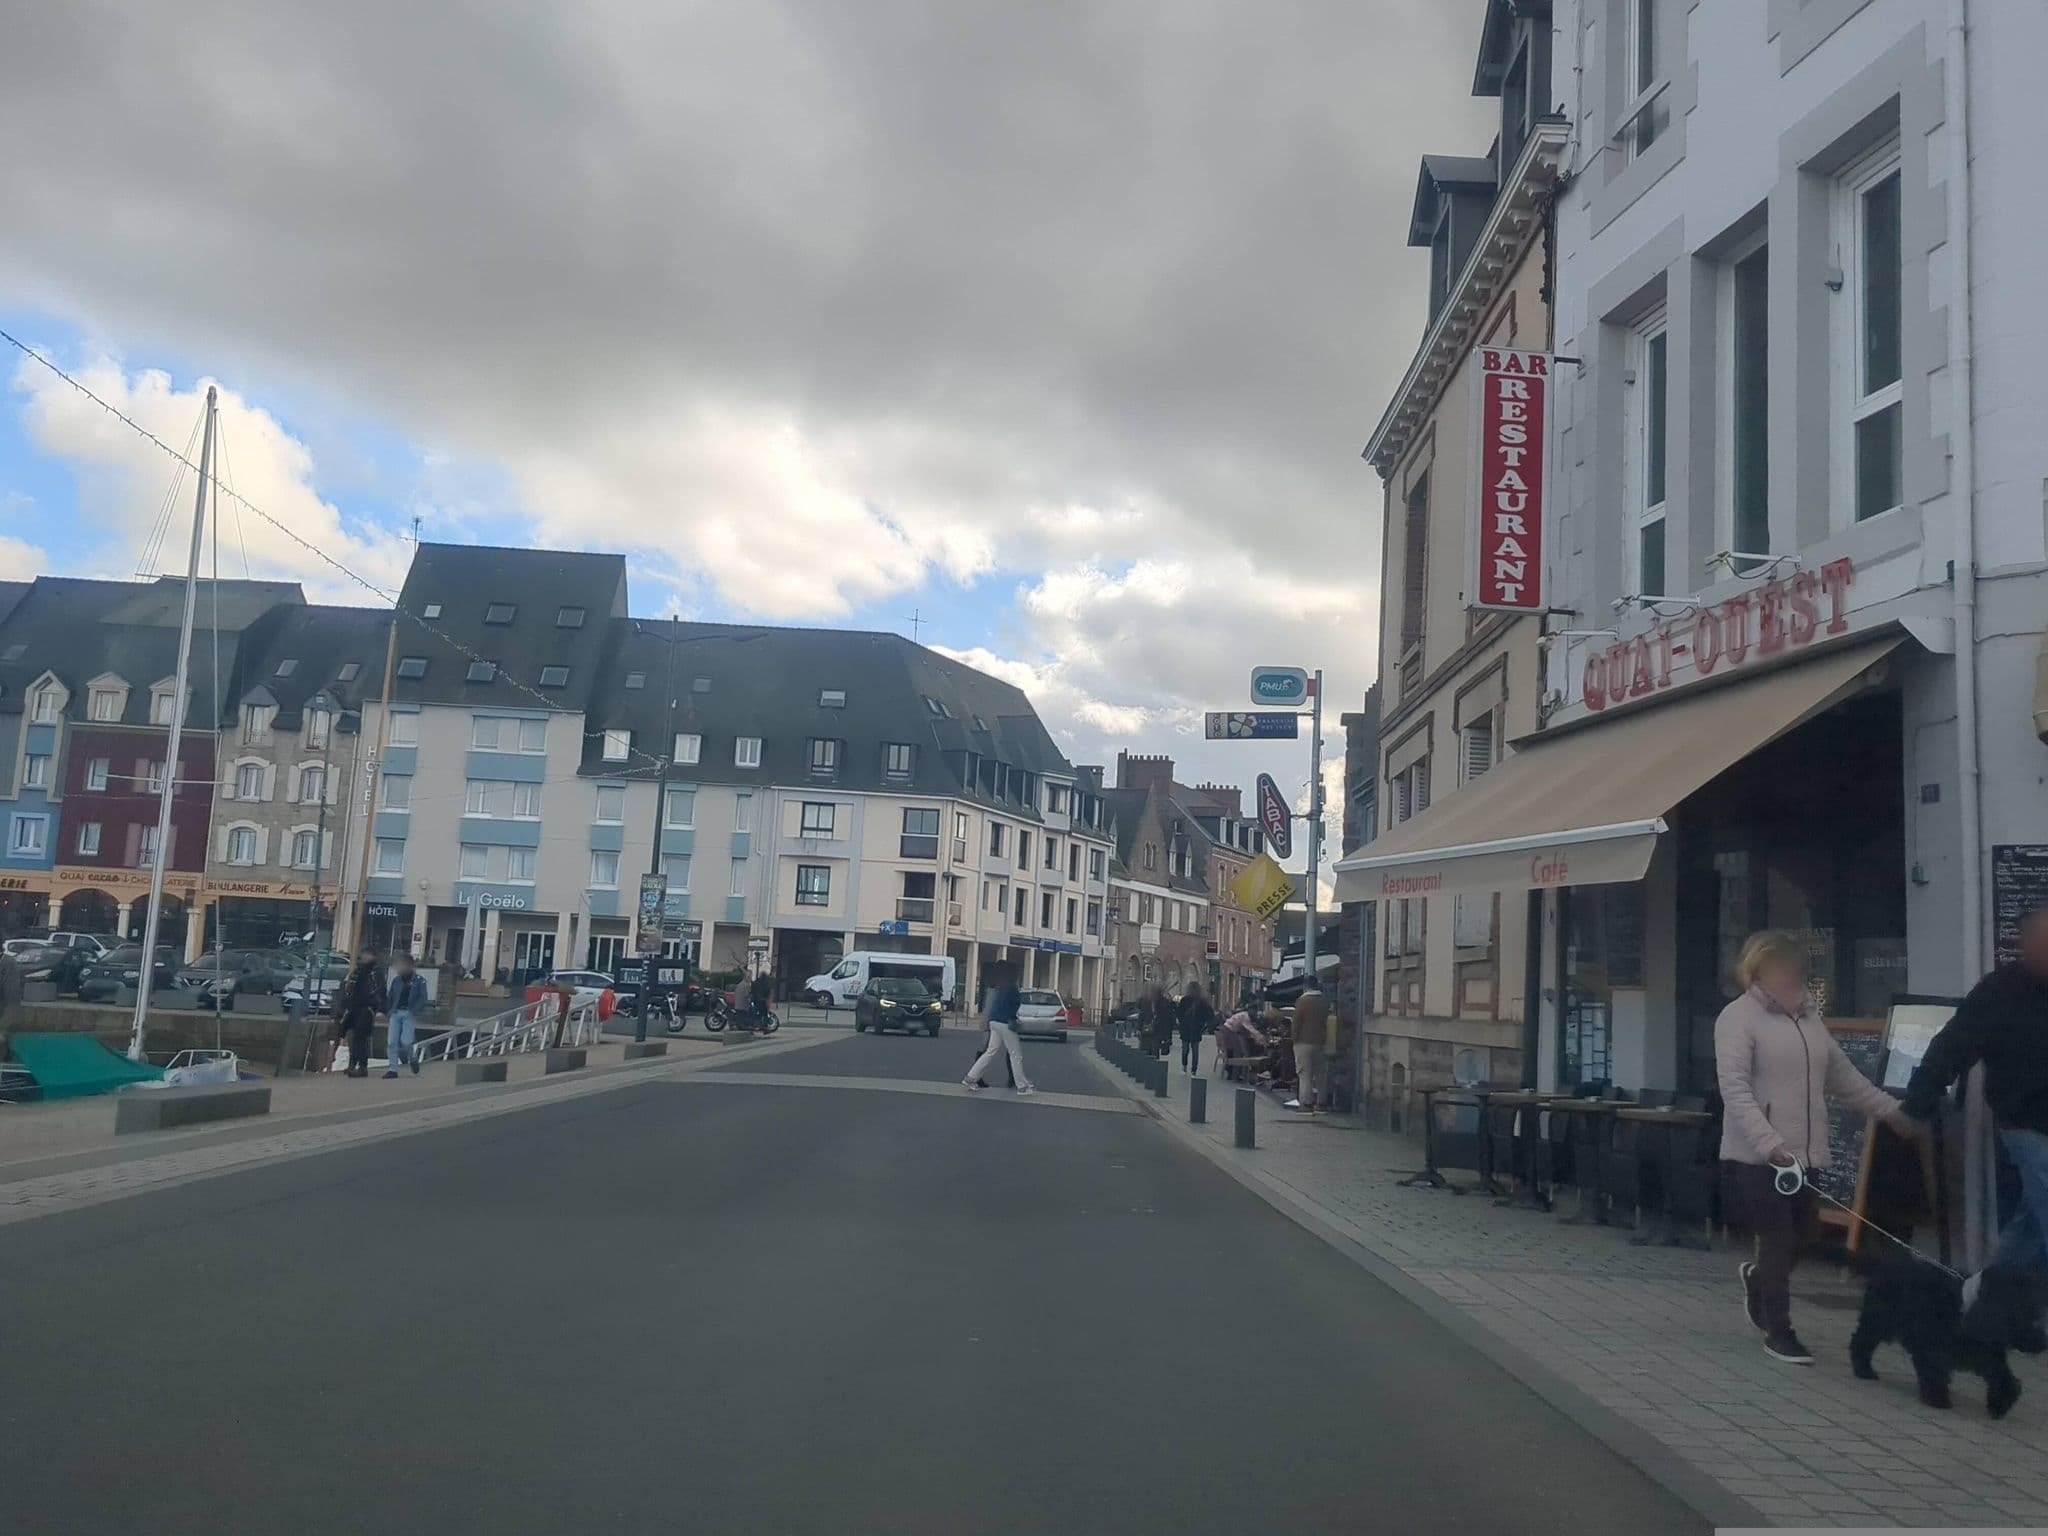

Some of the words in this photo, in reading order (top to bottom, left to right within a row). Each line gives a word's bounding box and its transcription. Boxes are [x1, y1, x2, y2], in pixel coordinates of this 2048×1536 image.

[1482, 351, 1548, 375] BAR
[1494, 378, 1531, 602] RESTAURANT
[1584, 557, 1853, 711] QUAI-OUEST
[1260, 682, 1281, 691] PMU
[1262, 785, 1285, 845] TABAC
[1531, 853, 1569, 882] Café
[207, 883, 269, 893] BOULANGERIE
[1382, 872, 1442, 894] Restaurant
[368, 905, 398, 916] HÔTEL
[480, 893, 525, 908] Goëlo
[1256, 884, 1292, 915] PRESSE
